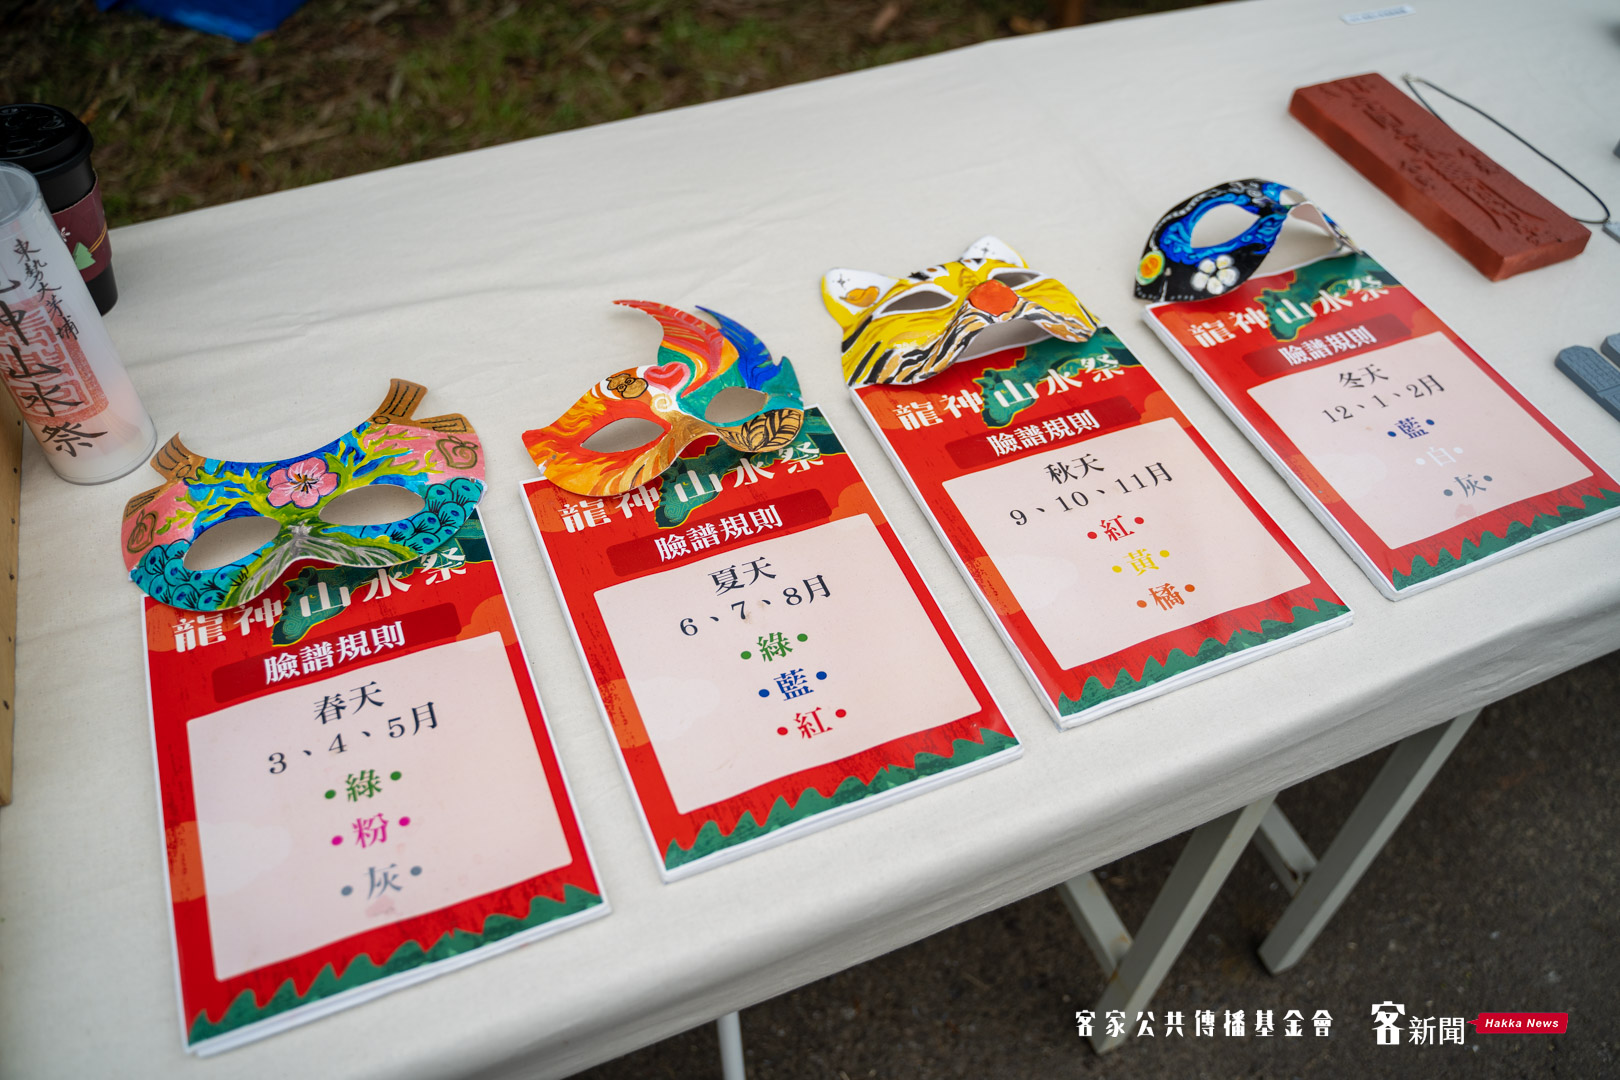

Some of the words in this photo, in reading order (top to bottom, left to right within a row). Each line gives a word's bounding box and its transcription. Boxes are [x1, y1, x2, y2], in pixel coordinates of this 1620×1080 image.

[1187, 275, 1389, 348] 龍神山水祭
[0, 278, 108, 458] 山水祭
[1278, 325, 1378, 366] 臉譜規則
[892, 353, 1125, 431] 龍神山水祭
[1338, 363, 1389, 390] 冬天
[986, 408, 1101, 457] 臉譜規則
[558, 441, 824, 533] 龍神山水祭
[1044, 453, 1105, 485] 秋天
[654, 504, 783, 562] 臉譜規則
[172, 547, 467, 653] 龍神山水祭
[708, 556, 777, 597] 夏天
[264, 621, 406, 685] 臉譜規則
[314, 681, 384, 726] 春天
